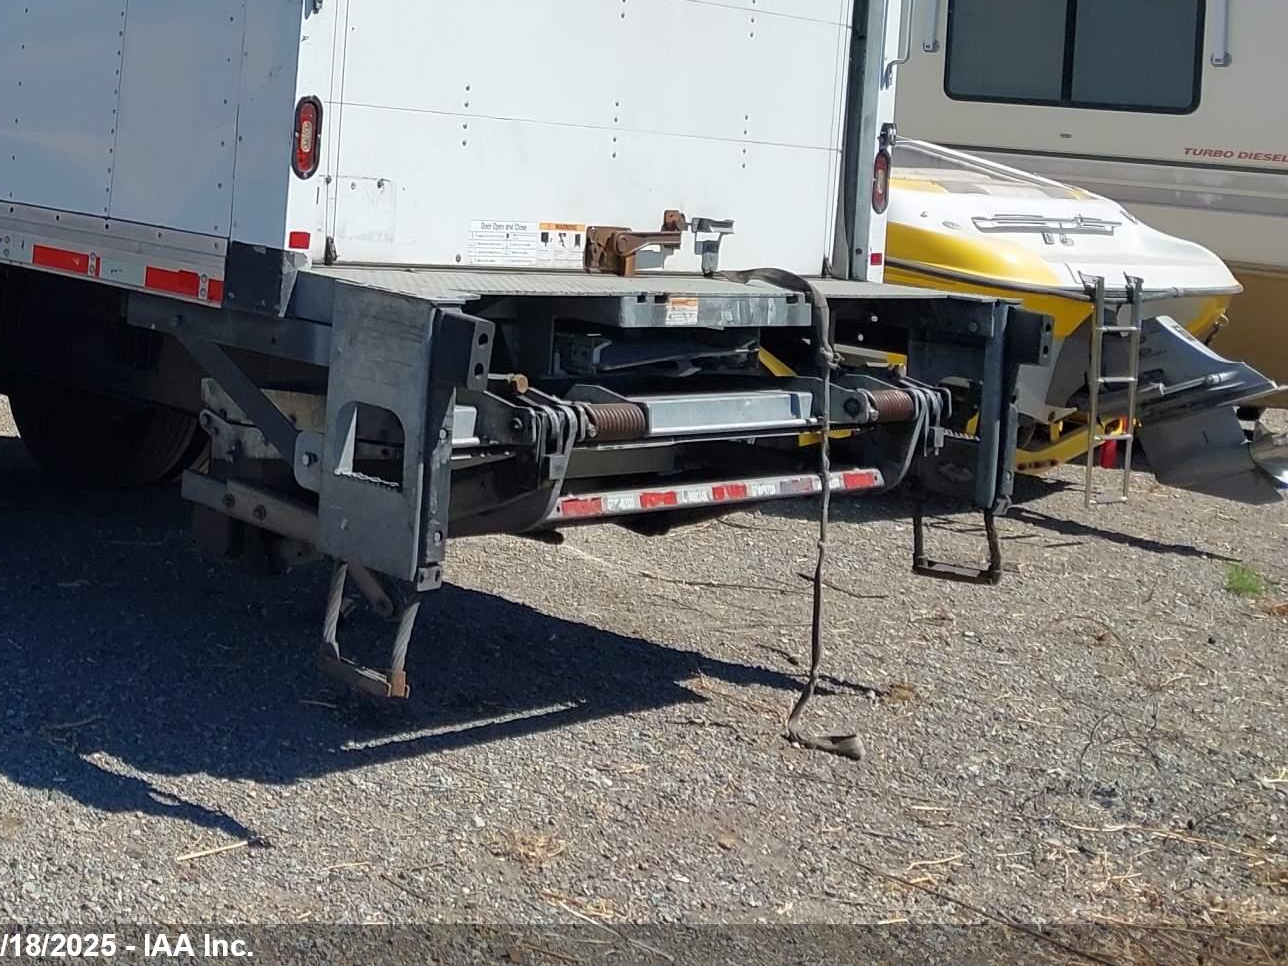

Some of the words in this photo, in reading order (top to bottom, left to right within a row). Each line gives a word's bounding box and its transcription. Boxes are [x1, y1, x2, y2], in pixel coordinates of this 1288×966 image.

[1184, 147, 1234, 159] TURBO
[1237, 151, 1288, 163] DIESEL
[480, 222, 492, 231] Door
[493, 222, 504, 232] Open
[505, 223, 514, 231] and
[515, 223, 527, 231] Close
